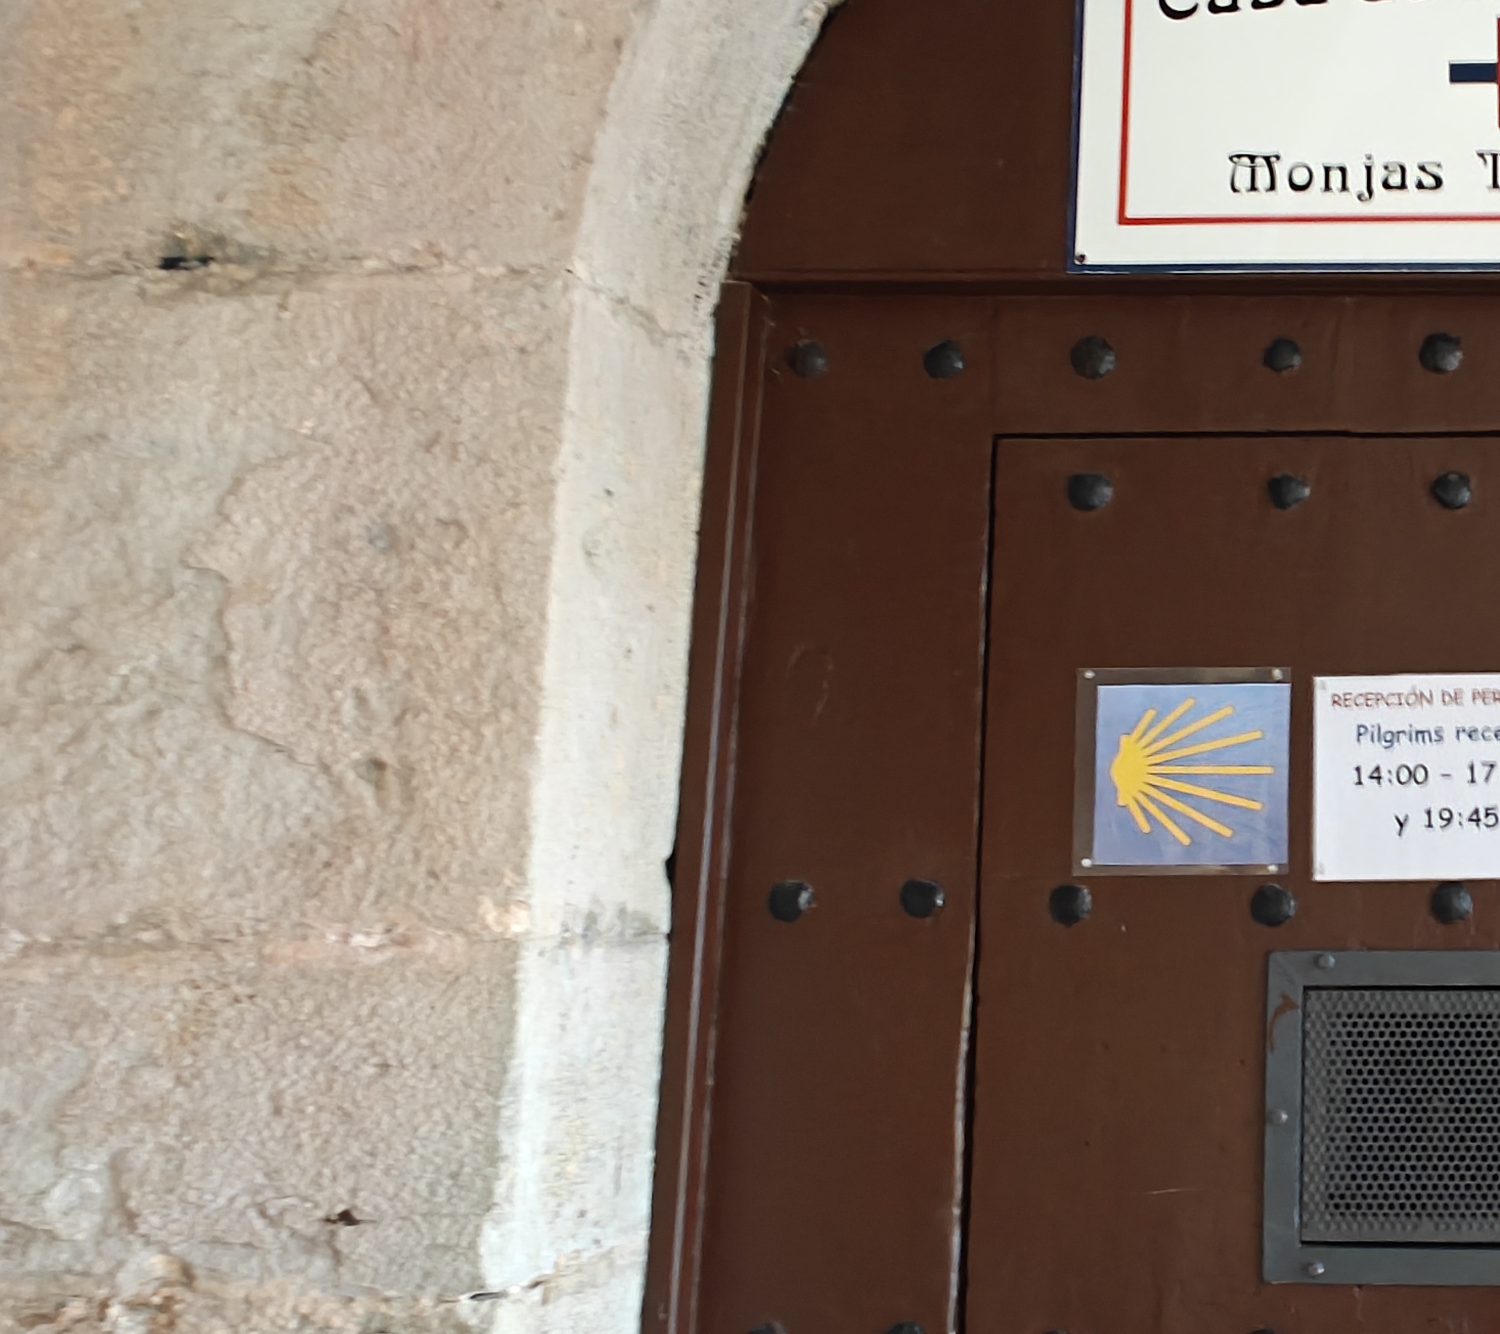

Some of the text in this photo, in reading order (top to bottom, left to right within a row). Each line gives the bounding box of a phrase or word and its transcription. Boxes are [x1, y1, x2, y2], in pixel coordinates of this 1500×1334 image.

[1228, 151, 1444, 202] Monjas
[1331, 685, 1434, 707] RECEPCIÓN
[1441, 689, 1463, 706] DE
[1356, 723, 1444, 749] Pilgrims
[1353, 764, 1429, 786] 14:00
[1395, 813, 1408, 836] y
[1424, 808, 1499, 830] 19:45
